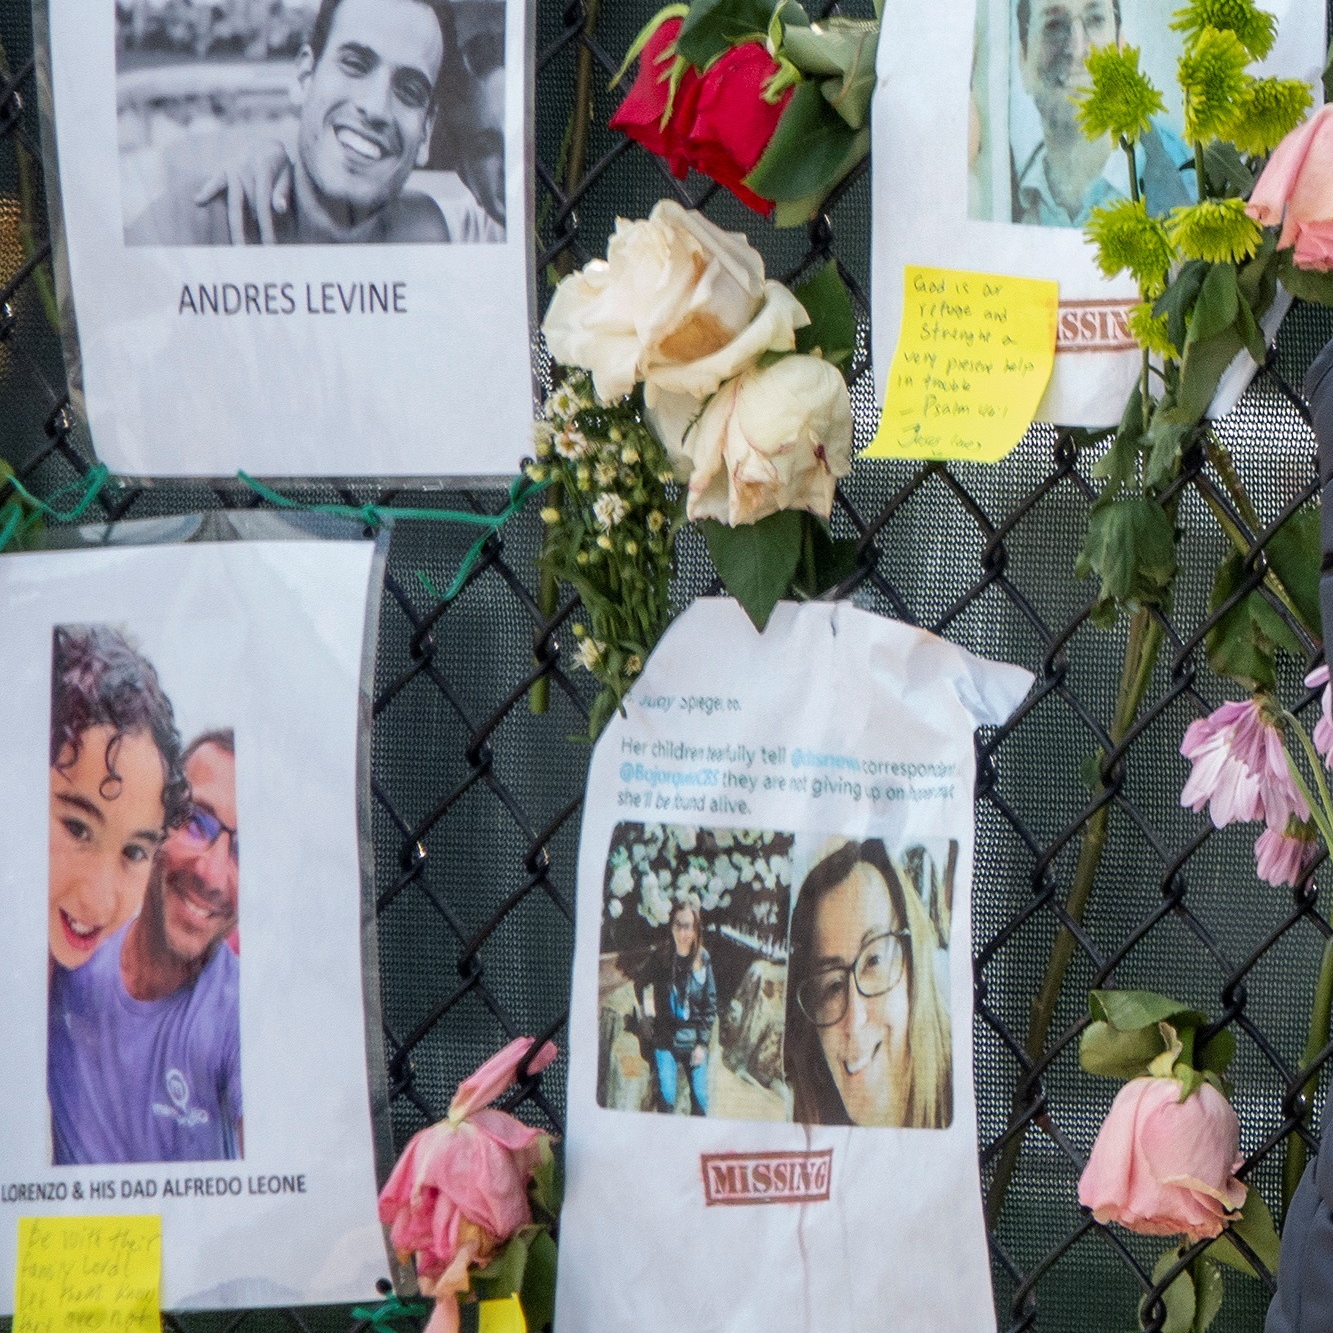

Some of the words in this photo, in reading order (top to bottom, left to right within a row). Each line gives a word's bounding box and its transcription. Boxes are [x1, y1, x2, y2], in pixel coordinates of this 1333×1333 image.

[913, 274, 946, 294] God
[955, 282, 970, 295] is
[178, 282, 296, 316] ANDRES
[305, 281, 408, 315] LEVINE
[919, 297, 972, 321] refuge
[984, 308, 1008, 323] and
[1002, 335, 1018, 346] a
[904, 352, 938, 369] very
[1004, 356, 1036, 378] help
[923, 392, 971, 419] Psalm
[621, 736, 647, 756] Her
[651, 740, 704, 762] children
[761, 745, 787, 765] tell
[723, 771, 758, 794] they
[763, 775, 787, 791] are
[811, 776, 862, 802] giving
[886, 785, 905, 801] on
[655, 792, 671, 810] be
[709, 795, 751, 815] alive.
[1, 1182, 68, 1203] LORENZO
[72, 1180, 84, 1201] &
[90, 1179, 117, 1200] HIS
[121, 1179, 158, 1199] DAD
[162, 1176, 243, 1197] ALFREDO
[247, 1174, 308, 1195] LEONE
[711, 1161, 828, 1195] MISSING
